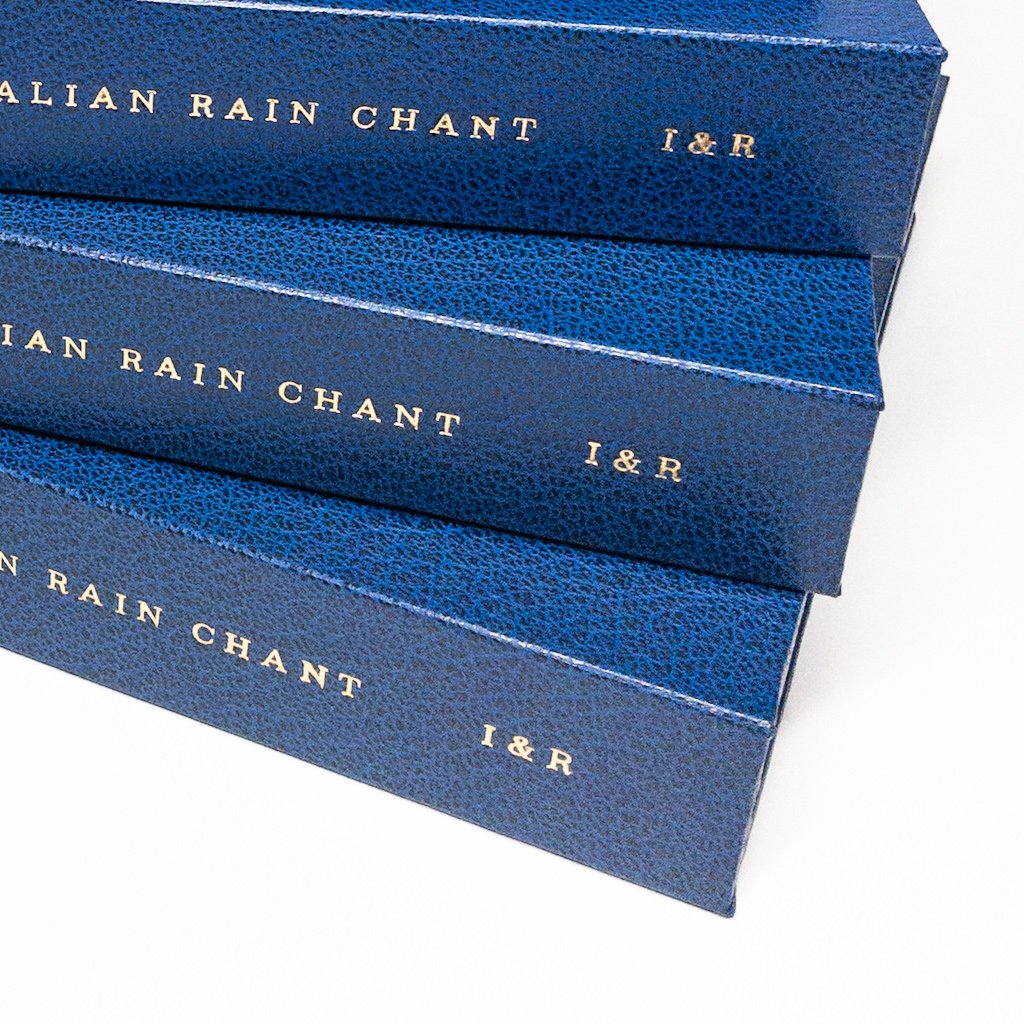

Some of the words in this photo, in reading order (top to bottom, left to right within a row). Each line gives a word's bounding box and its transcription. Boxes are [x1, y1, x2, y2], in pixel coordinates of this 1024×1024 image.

[190, 94, 318, 125] RAIN
[352, 106, 536, 141] CHANT
[120, 348, 244, 391] RAIN
[279, 381, 460, 436] CHANT
[46, 569, 163, 627] RAIN
[191, 623, 361, 697] CHANT
